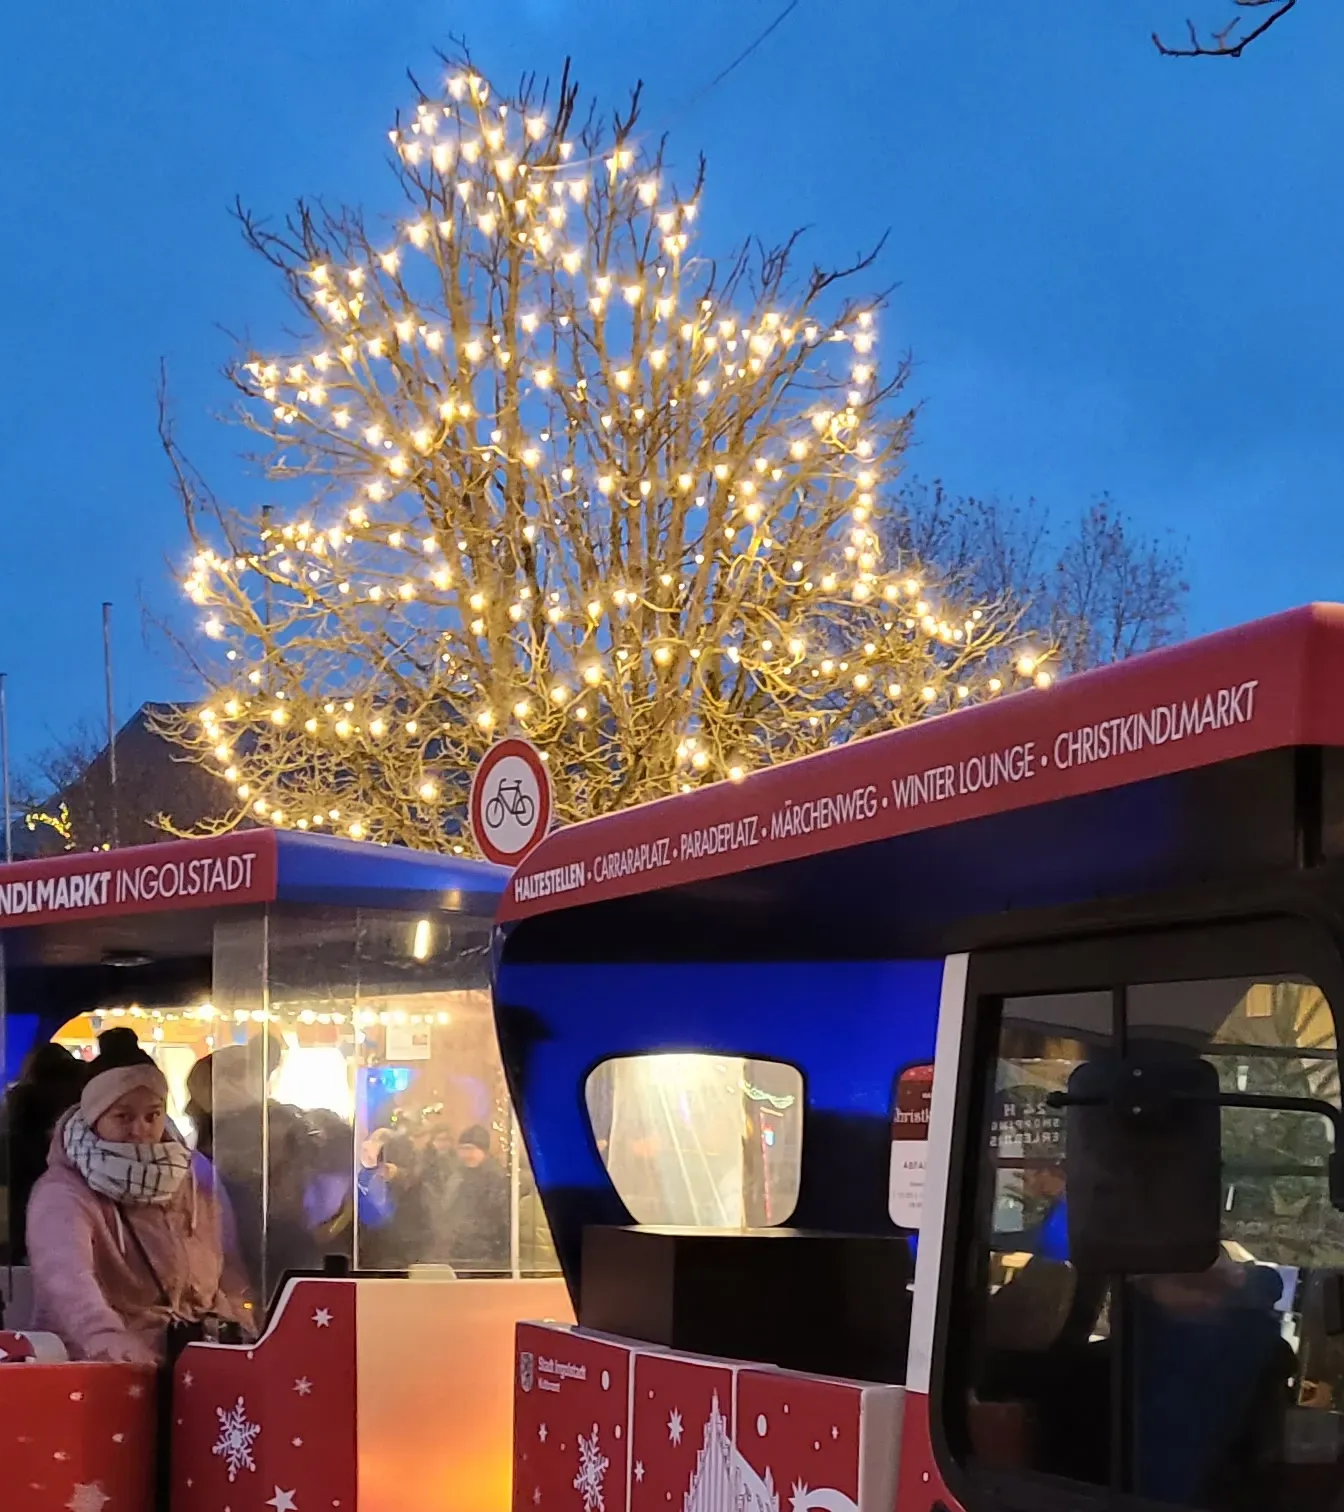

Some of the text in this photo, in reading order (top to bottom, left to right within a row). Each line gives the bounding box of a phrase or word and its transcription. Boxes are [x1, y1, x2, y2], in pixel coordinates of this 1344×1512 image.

[515, 680, 1259, 902] HALTESTELLEN CARRARAPLATZ PARADEPLATZ MÄRCHENWEG WINTER LOUNGE CHRISTKINDLMARKT
[115, 853, 256, 903] INGOLSTADT
